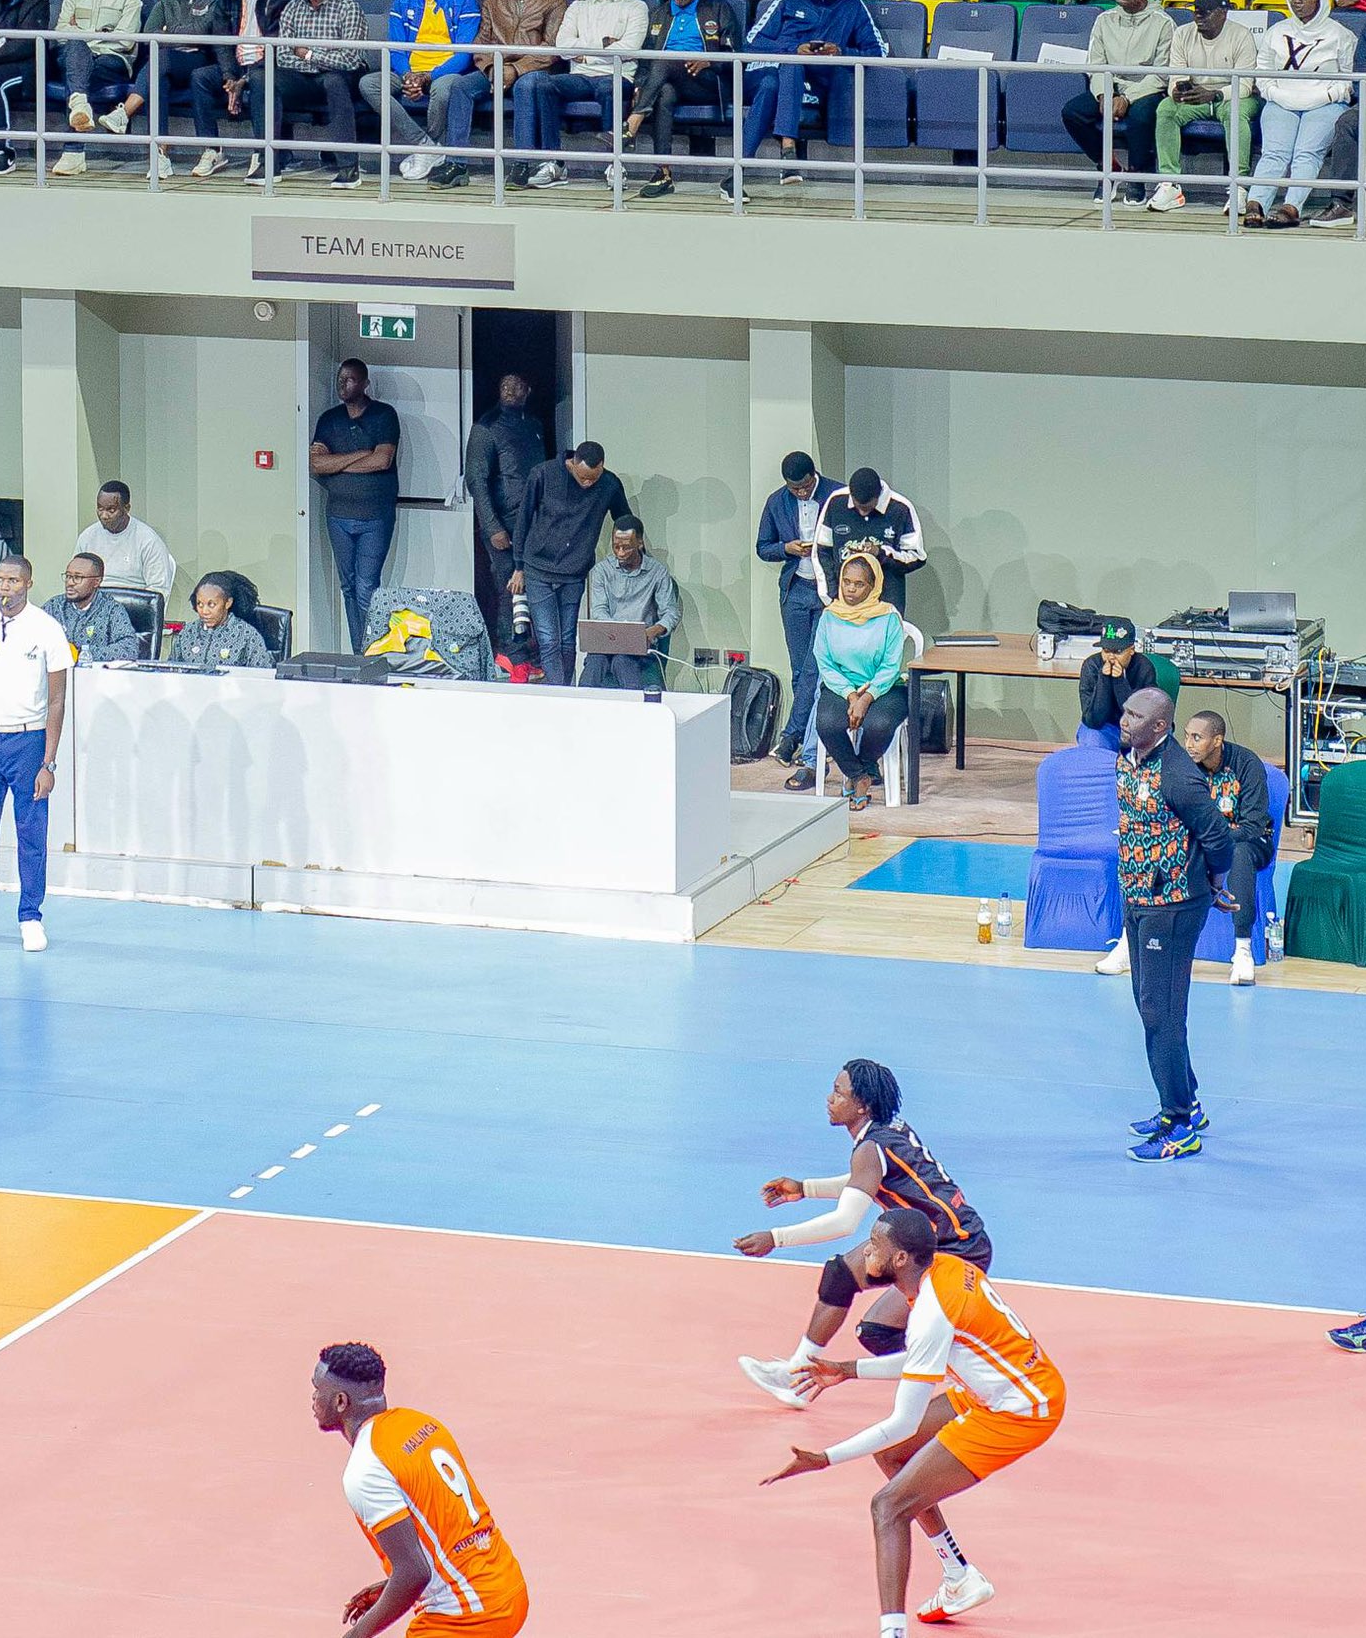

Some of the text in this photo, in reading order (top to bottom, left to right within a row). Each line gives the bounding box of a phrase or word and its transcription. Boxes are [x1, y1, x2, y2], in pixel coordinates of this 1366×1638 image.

[880, 7, 890, 16] 17
[1058, 10, 1068, 19] 19
[302, 235, 466, 261] TEAM ENTRANCE
[978, 1278, 1033, 1341] 8
[402, 1421, 440, 1457] MALINGA
[429, 1447, 481, 1527] 9
